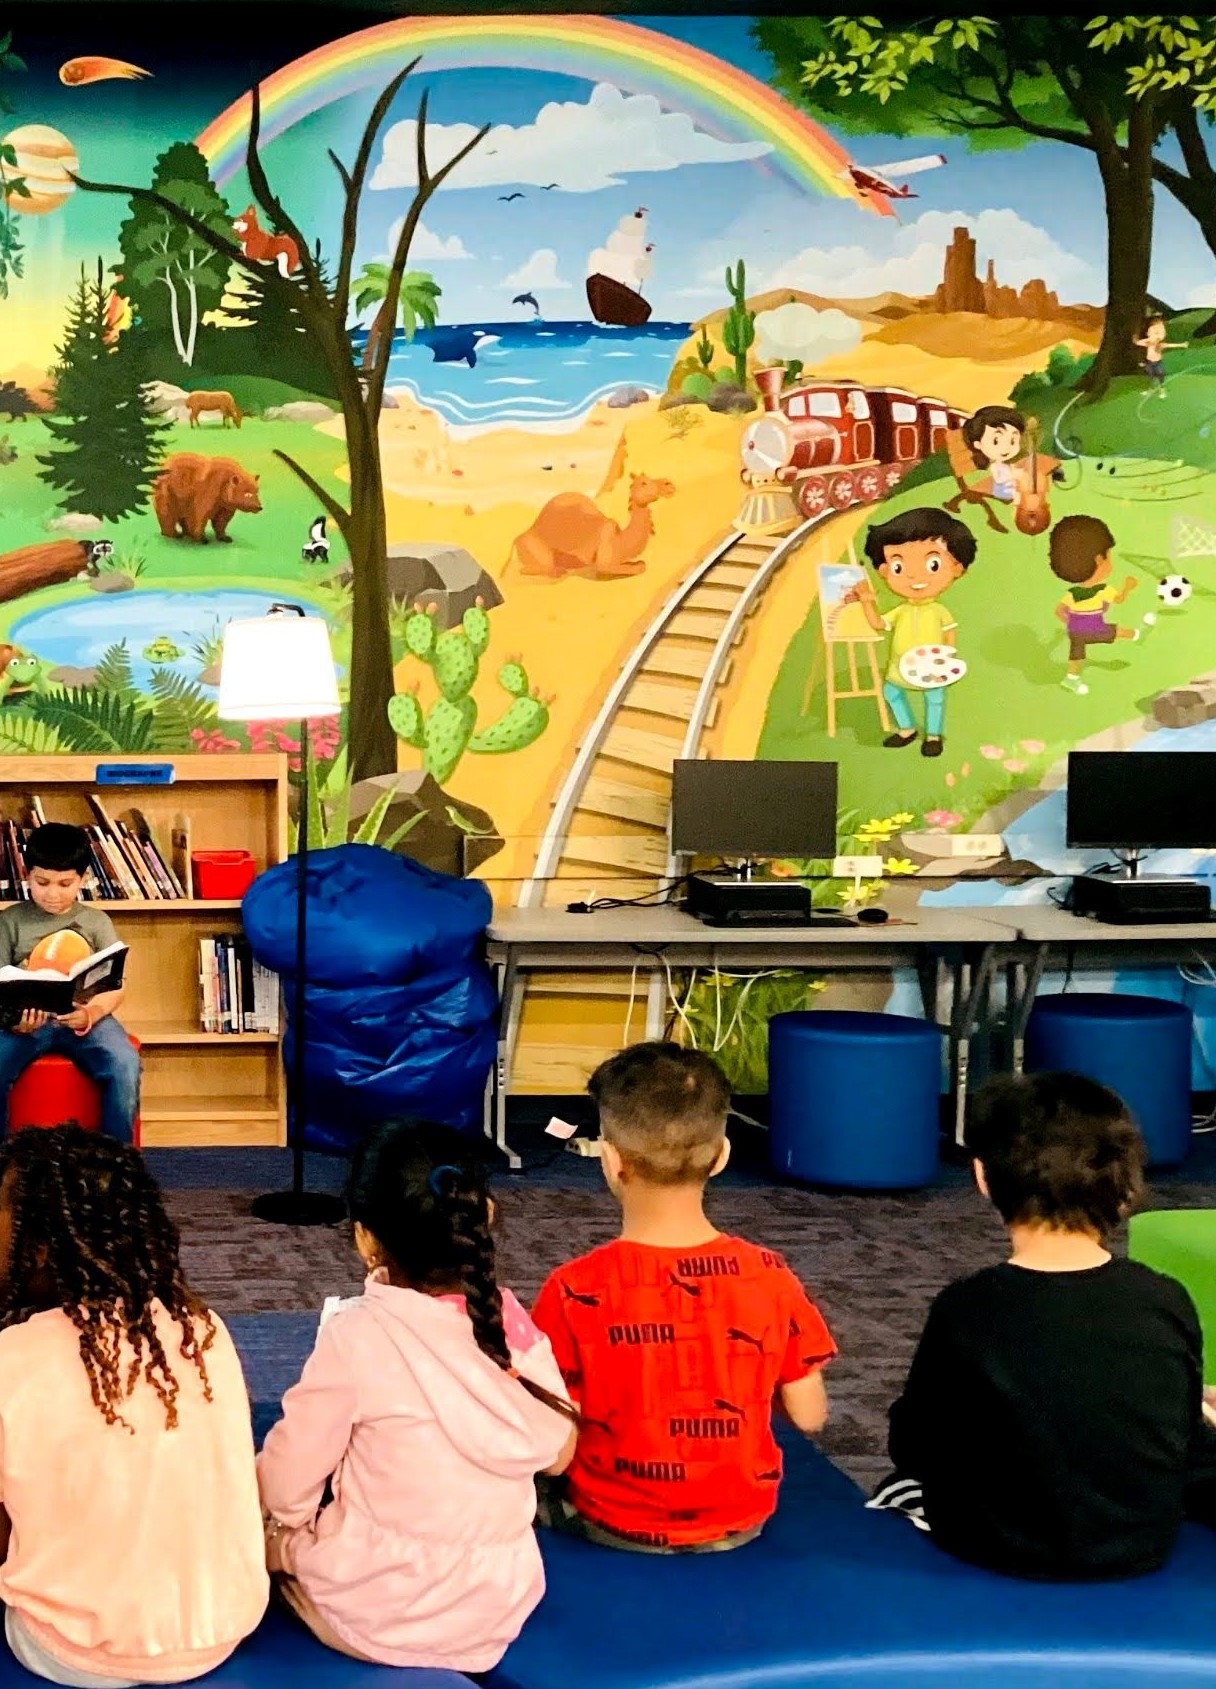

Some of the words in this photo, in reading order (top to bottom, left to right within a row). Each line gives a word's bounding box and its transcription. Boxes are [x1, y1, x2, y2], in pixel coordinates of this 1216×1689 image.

[676, 1255, 740, 1277] PUMA
[761, 1251, 785, 1269] PU
[608, 1323, 675, 1346] PUMA
[669, 1418, 740, 1438] PUMA
[614, 1457, 686, 1482] PUMA
